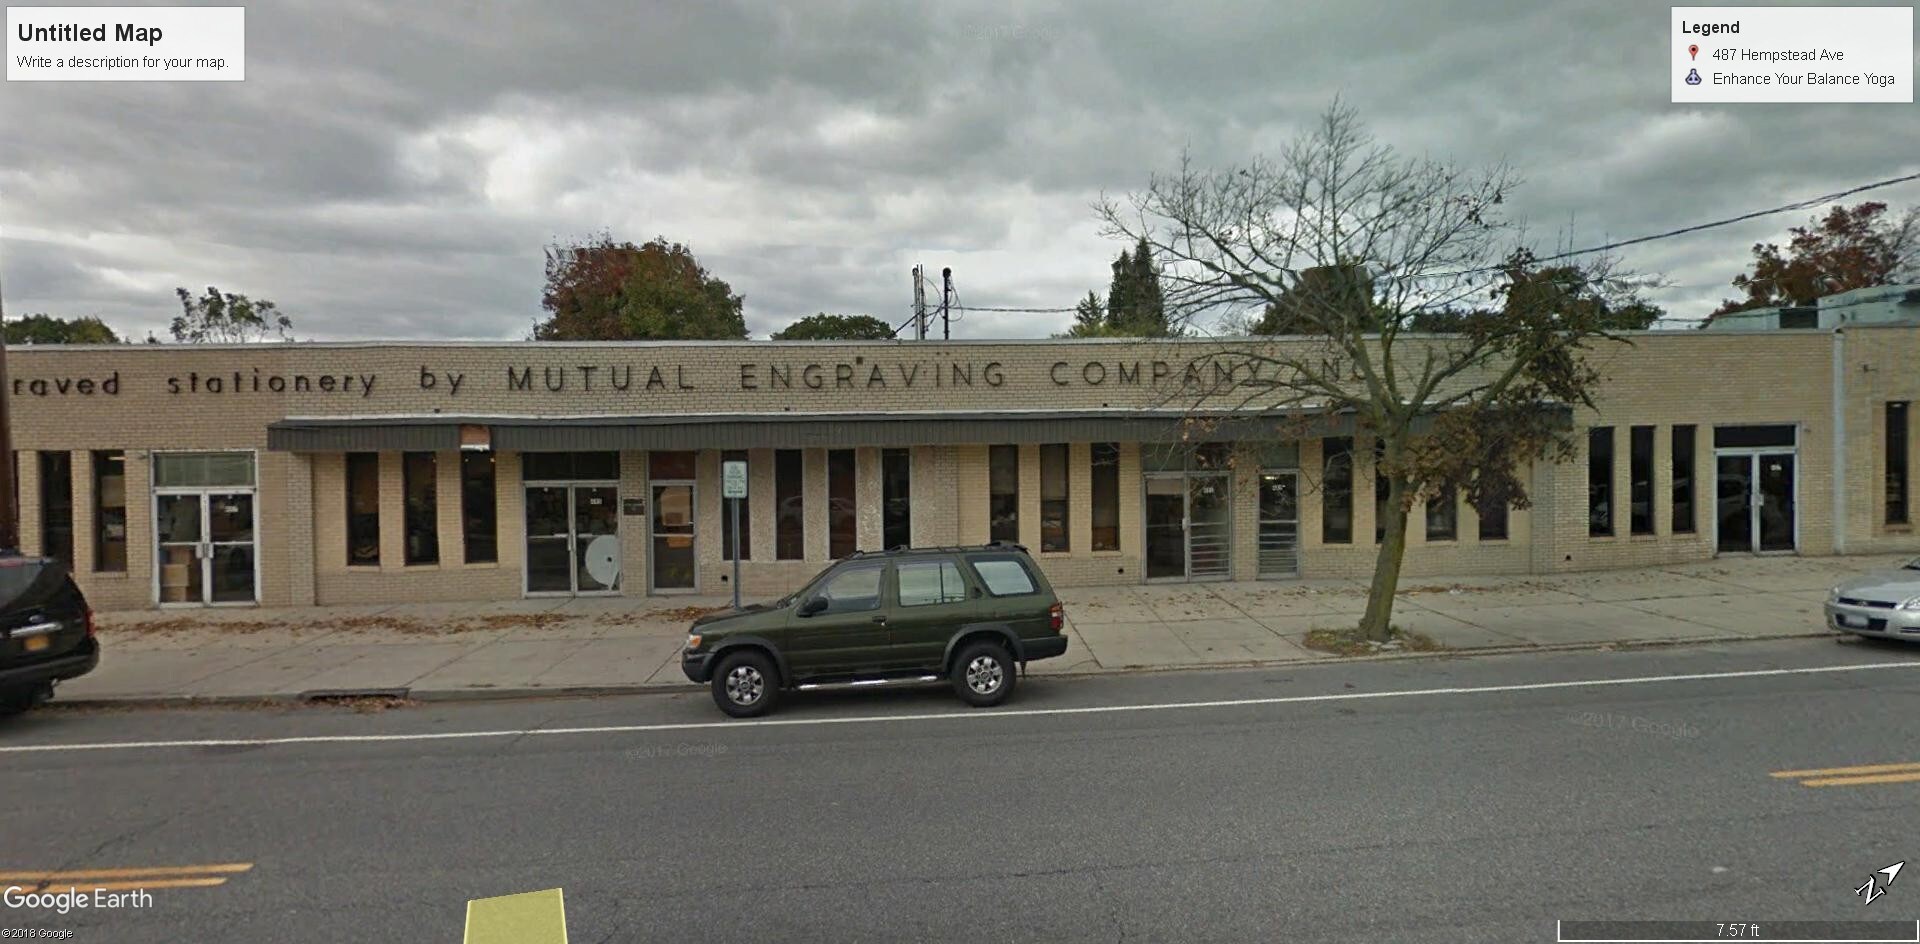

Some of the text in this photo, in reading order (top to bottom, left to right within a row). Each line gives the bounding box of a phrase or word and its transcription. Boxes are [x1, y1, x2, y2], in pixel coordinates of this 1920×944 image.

[167, 367, 377, 396] stationery
[420, 366, 465, 396] by
[508, 365, 695, 392] MUTUAL
[741, 362, 1004, 390] ENGRAVING
